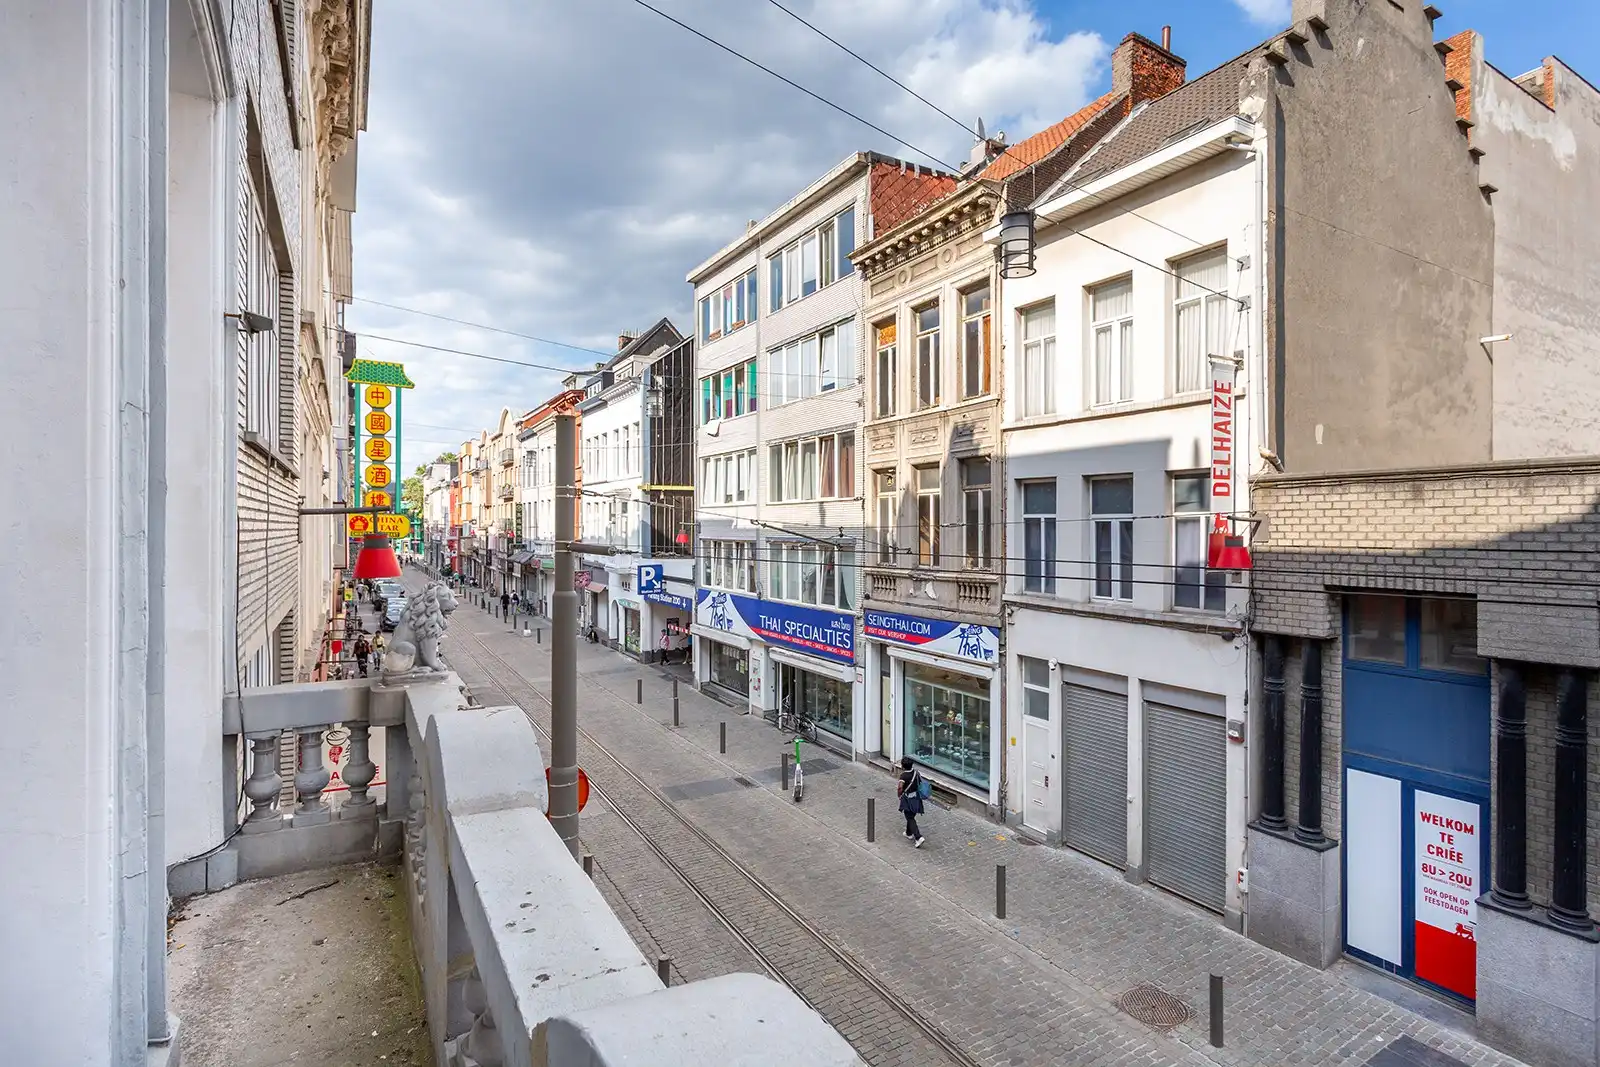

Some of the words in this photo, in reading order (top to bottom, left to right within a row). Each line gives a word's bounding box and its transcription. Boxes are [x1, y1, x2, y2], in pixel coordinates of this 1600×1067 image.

[1213, 380, 1232, 497] DELHAIZE
[641, 566, 656, 587] P
[660, 593, 673, 603] Station
[672, 595, 681, 606] ZOO
[759, 615, 781, 632] THAI
[784, 620, 851, 649] SPECIALTIES
[868, 614, 931, 636] SEINGTHAI.COM
[964, 625, 982, 635] SEING
[1420, 811, 1474, 836] WELKOM
[1439, 831, 1454, 846] TE
[1427, 844, 1464, 864] CRIÉE
[1421, 863, 1437, 875] 8U
[1449, 871, 1473, 887] 20U
[1423, 886, 1438, 897] OOK
[1439, 892, 1458, 904] OPEN
[1459, 898, 1470, 907] OP
[1424, 895, 1469, 916] FEESTDAGEN
